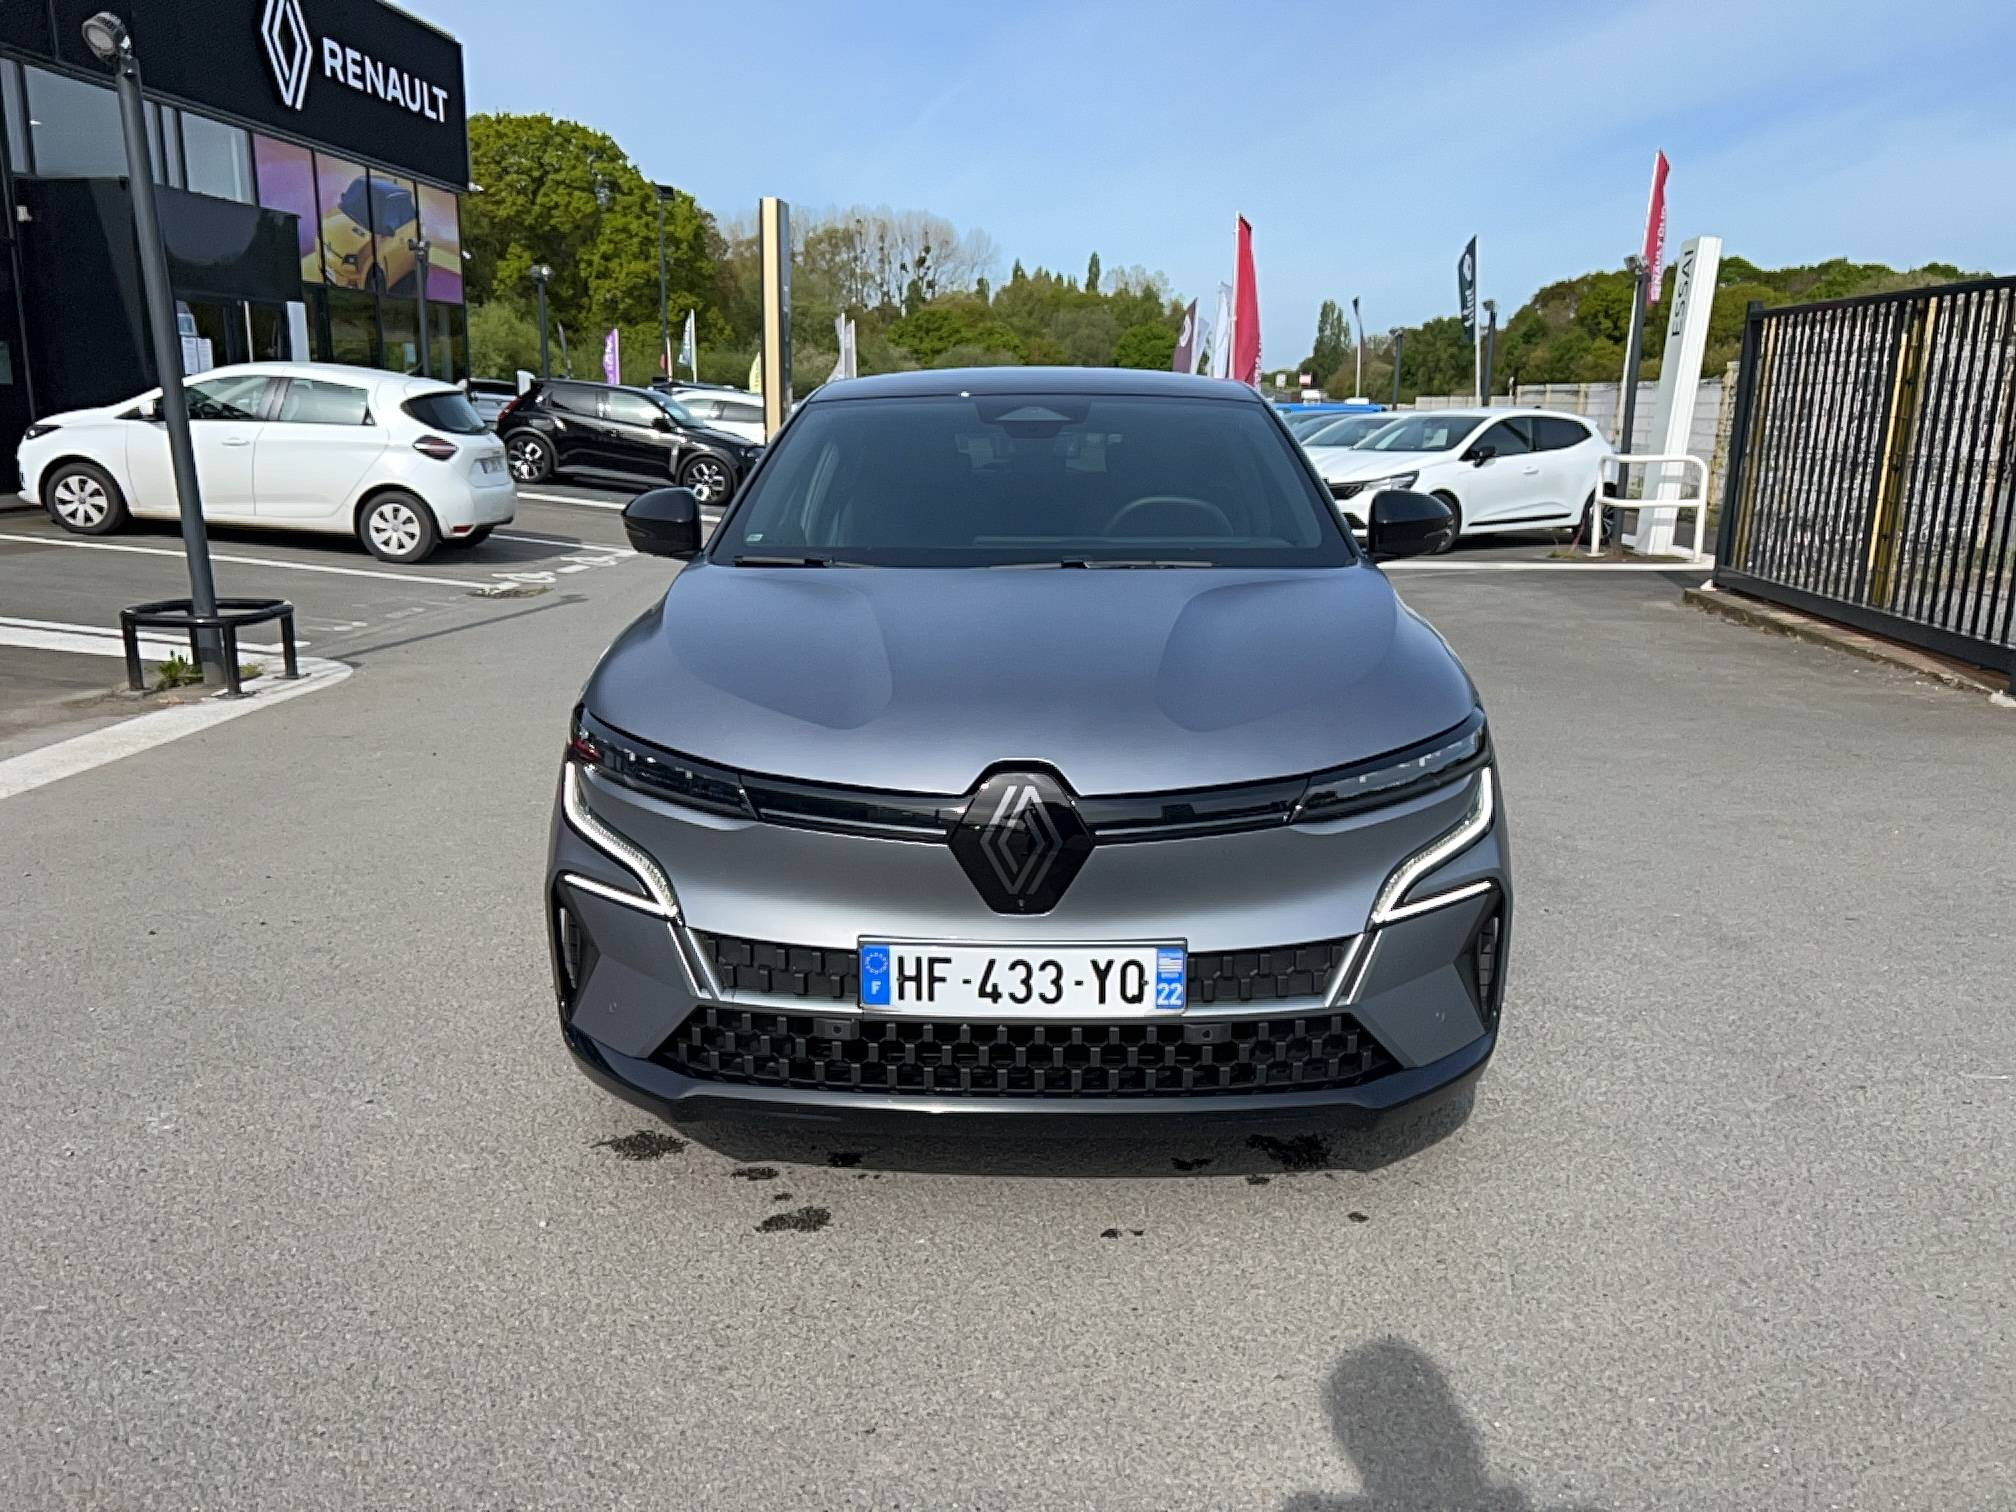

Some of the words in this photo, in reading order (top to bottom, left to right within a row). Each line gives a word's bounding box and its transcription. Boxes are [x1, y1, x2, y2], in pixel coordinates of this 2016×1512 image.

[322, 37, 448, 123] RENAULT
[1671, 249, 1694, 337] ESSAI
[871, 980, 881, 995] F
[897, 955, 1146, 1005] HF-433-YQ
[1157, 982, 1182, 1006] 22
